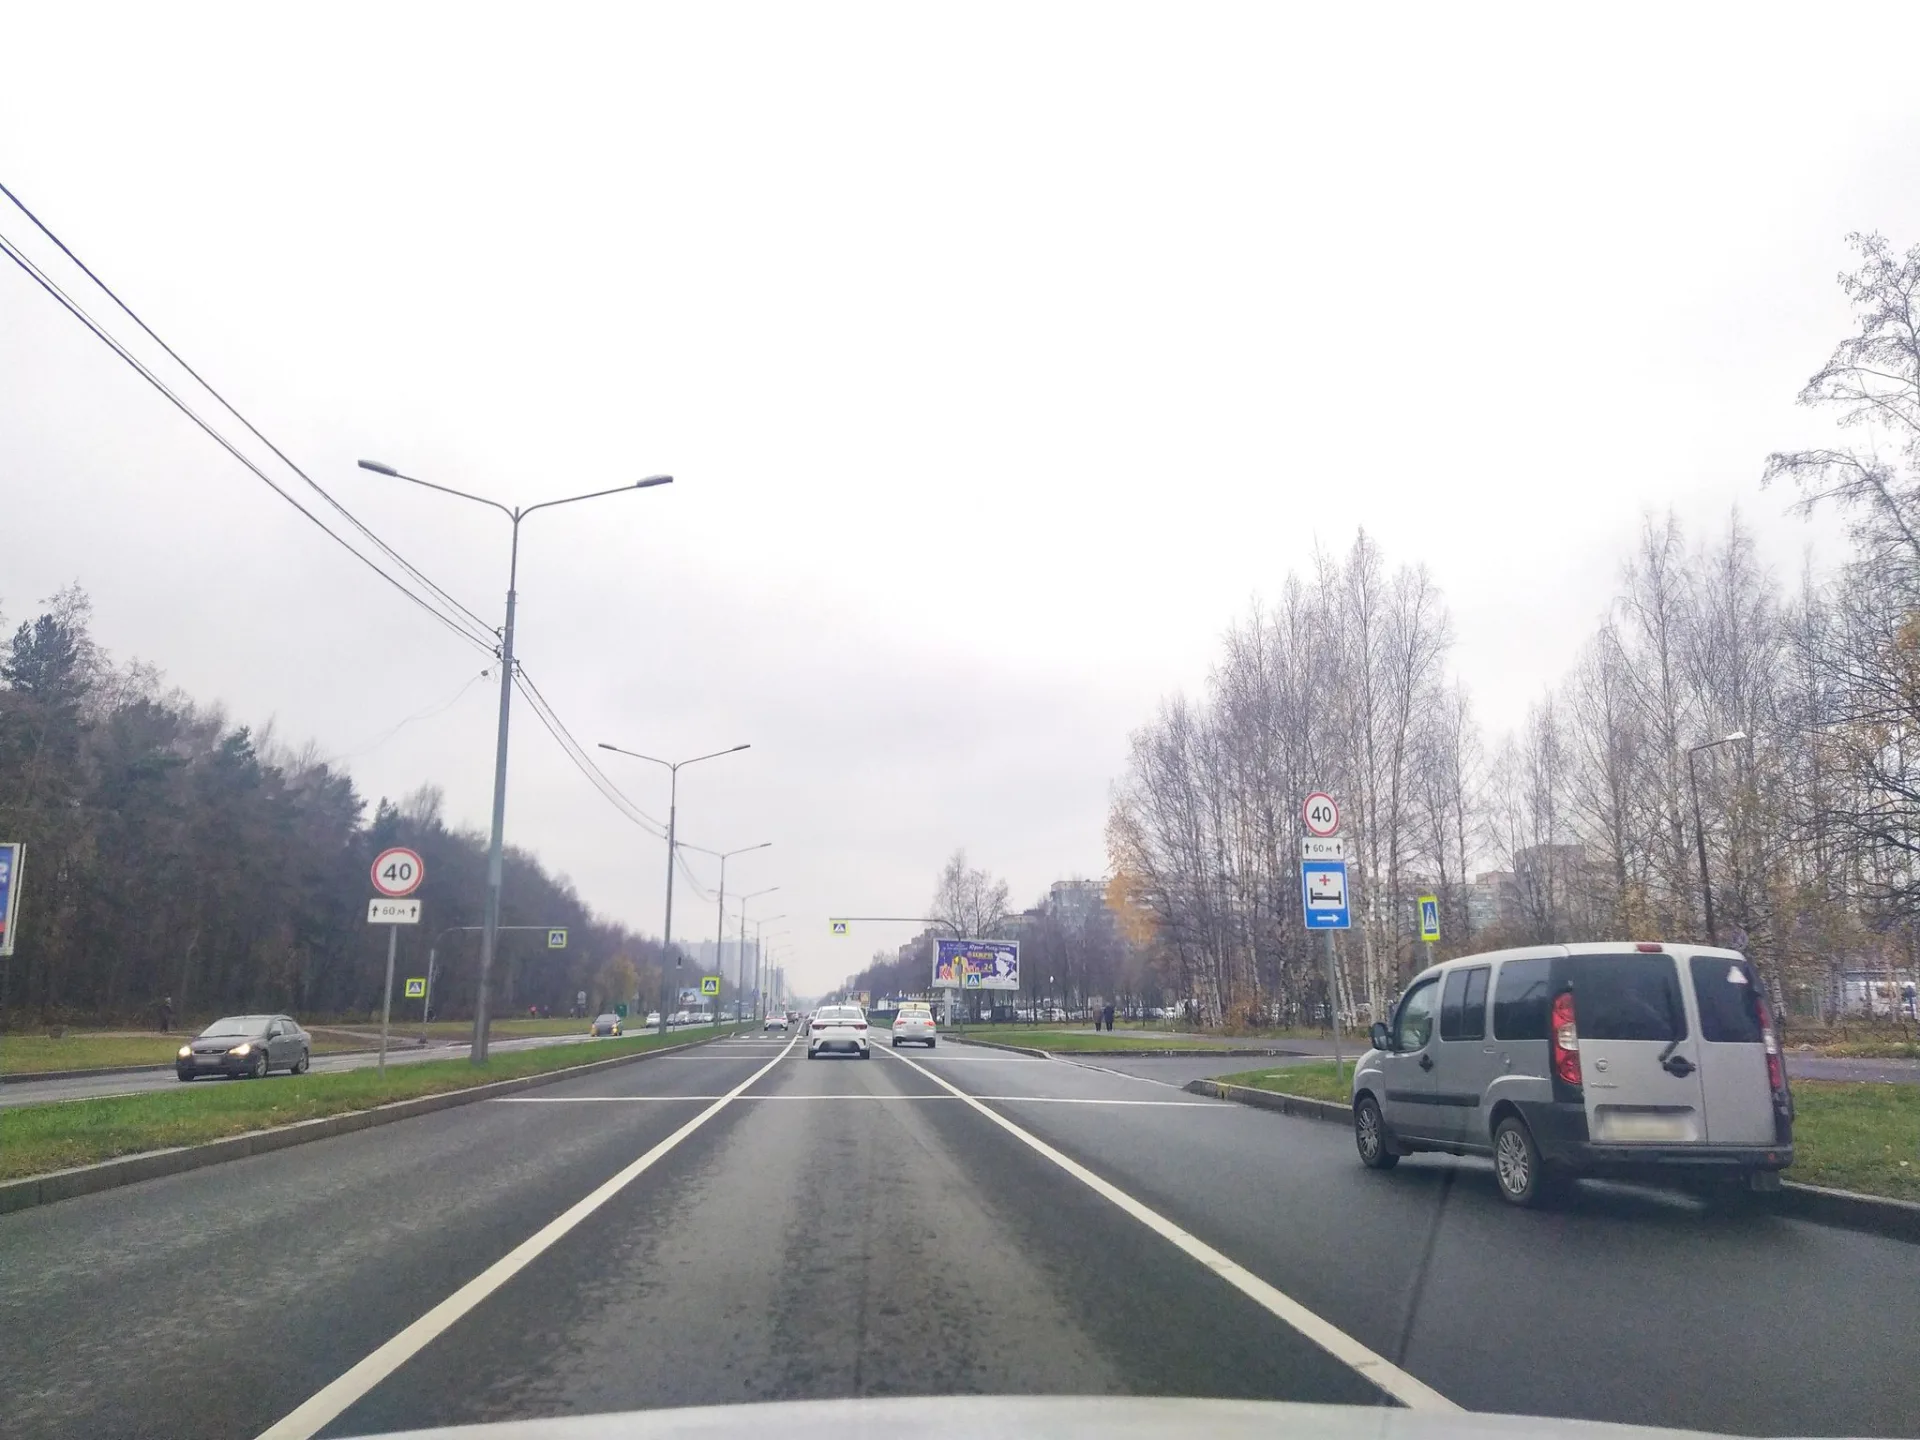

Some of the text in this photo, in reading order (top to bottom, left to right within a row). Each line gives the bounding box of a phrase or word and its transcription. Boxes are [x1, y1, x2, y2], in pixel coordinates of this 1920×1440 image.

[1311, 806, 1332, 822] 40
[1313, 844, 1324, 852] 60
[383, 863, 411, 881] 40
[382, 906, 395, 915] 60
